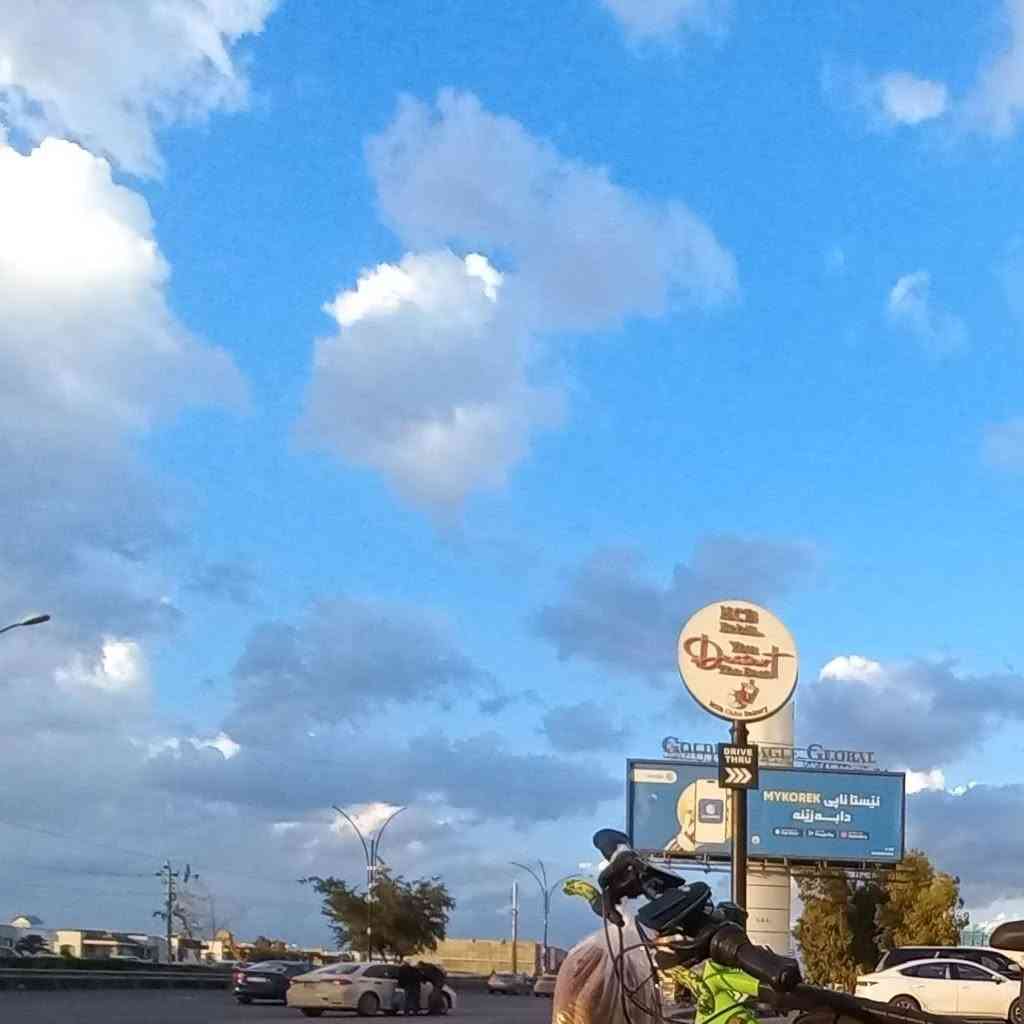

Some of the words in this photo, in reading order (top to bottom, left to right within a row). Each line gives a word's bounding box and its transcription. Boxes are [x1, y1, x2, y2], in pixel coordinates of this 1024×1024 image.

[723, 747, 753, 757] DRIVE
[724, 756, 752, 765] THRU
[763, 790, 821, 803] MYKOREK
